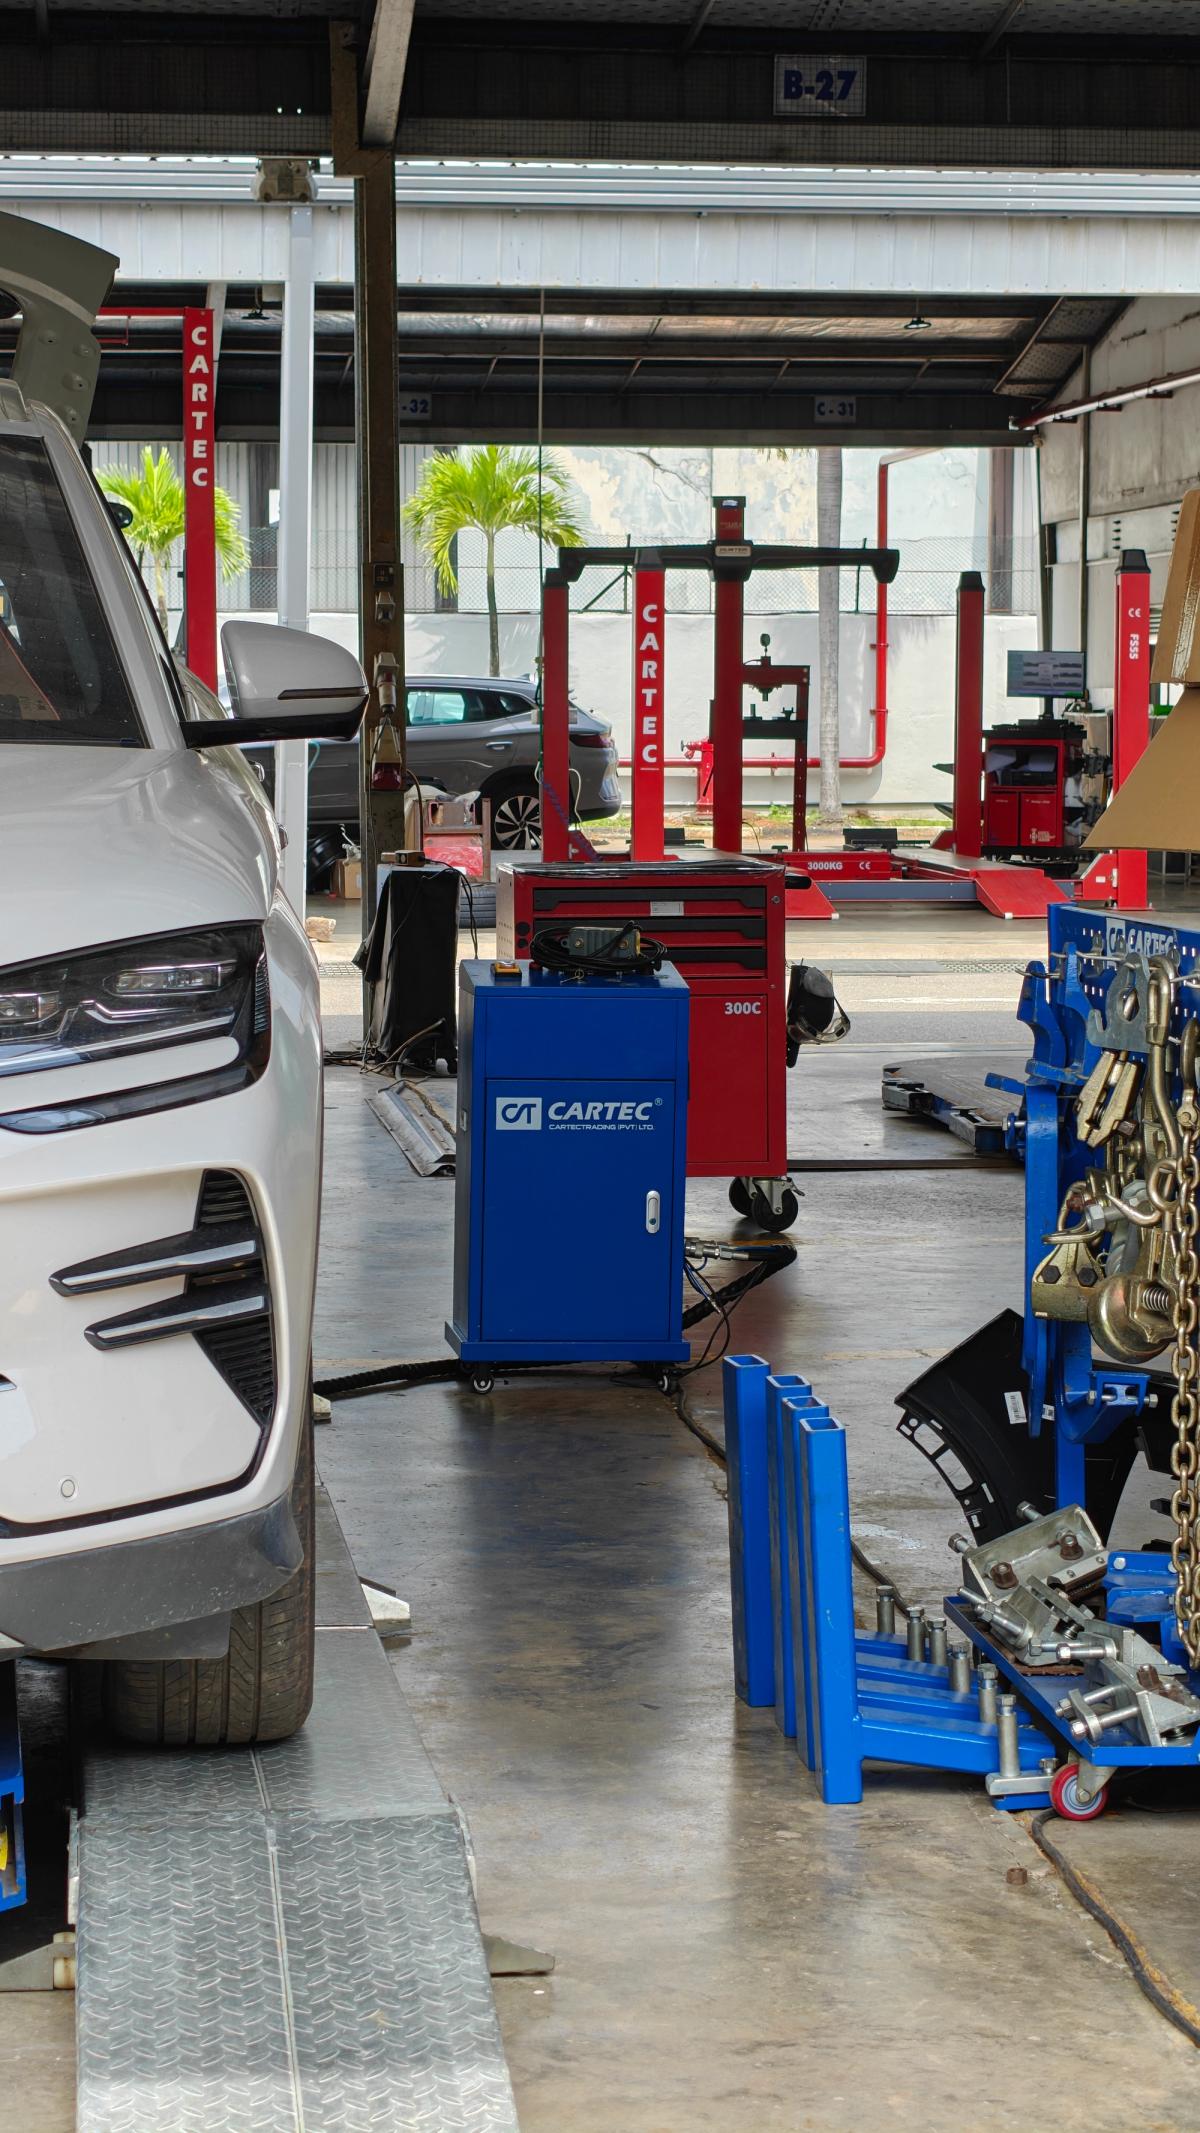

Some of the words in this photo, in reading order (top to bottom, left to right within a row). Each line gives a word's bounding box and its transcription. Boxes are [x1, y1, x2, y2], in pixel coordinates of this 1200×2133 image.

[783, 69, 857, 100] B-27
[188, 326, 209, 487] CARTEC
[639, 604, 660, 763] CARTEC
[807, 861, 843, 870] 3000KG
[724, 1001, 761, 1015] 300C
[547, 1101, 653, 1121] CARTEC
